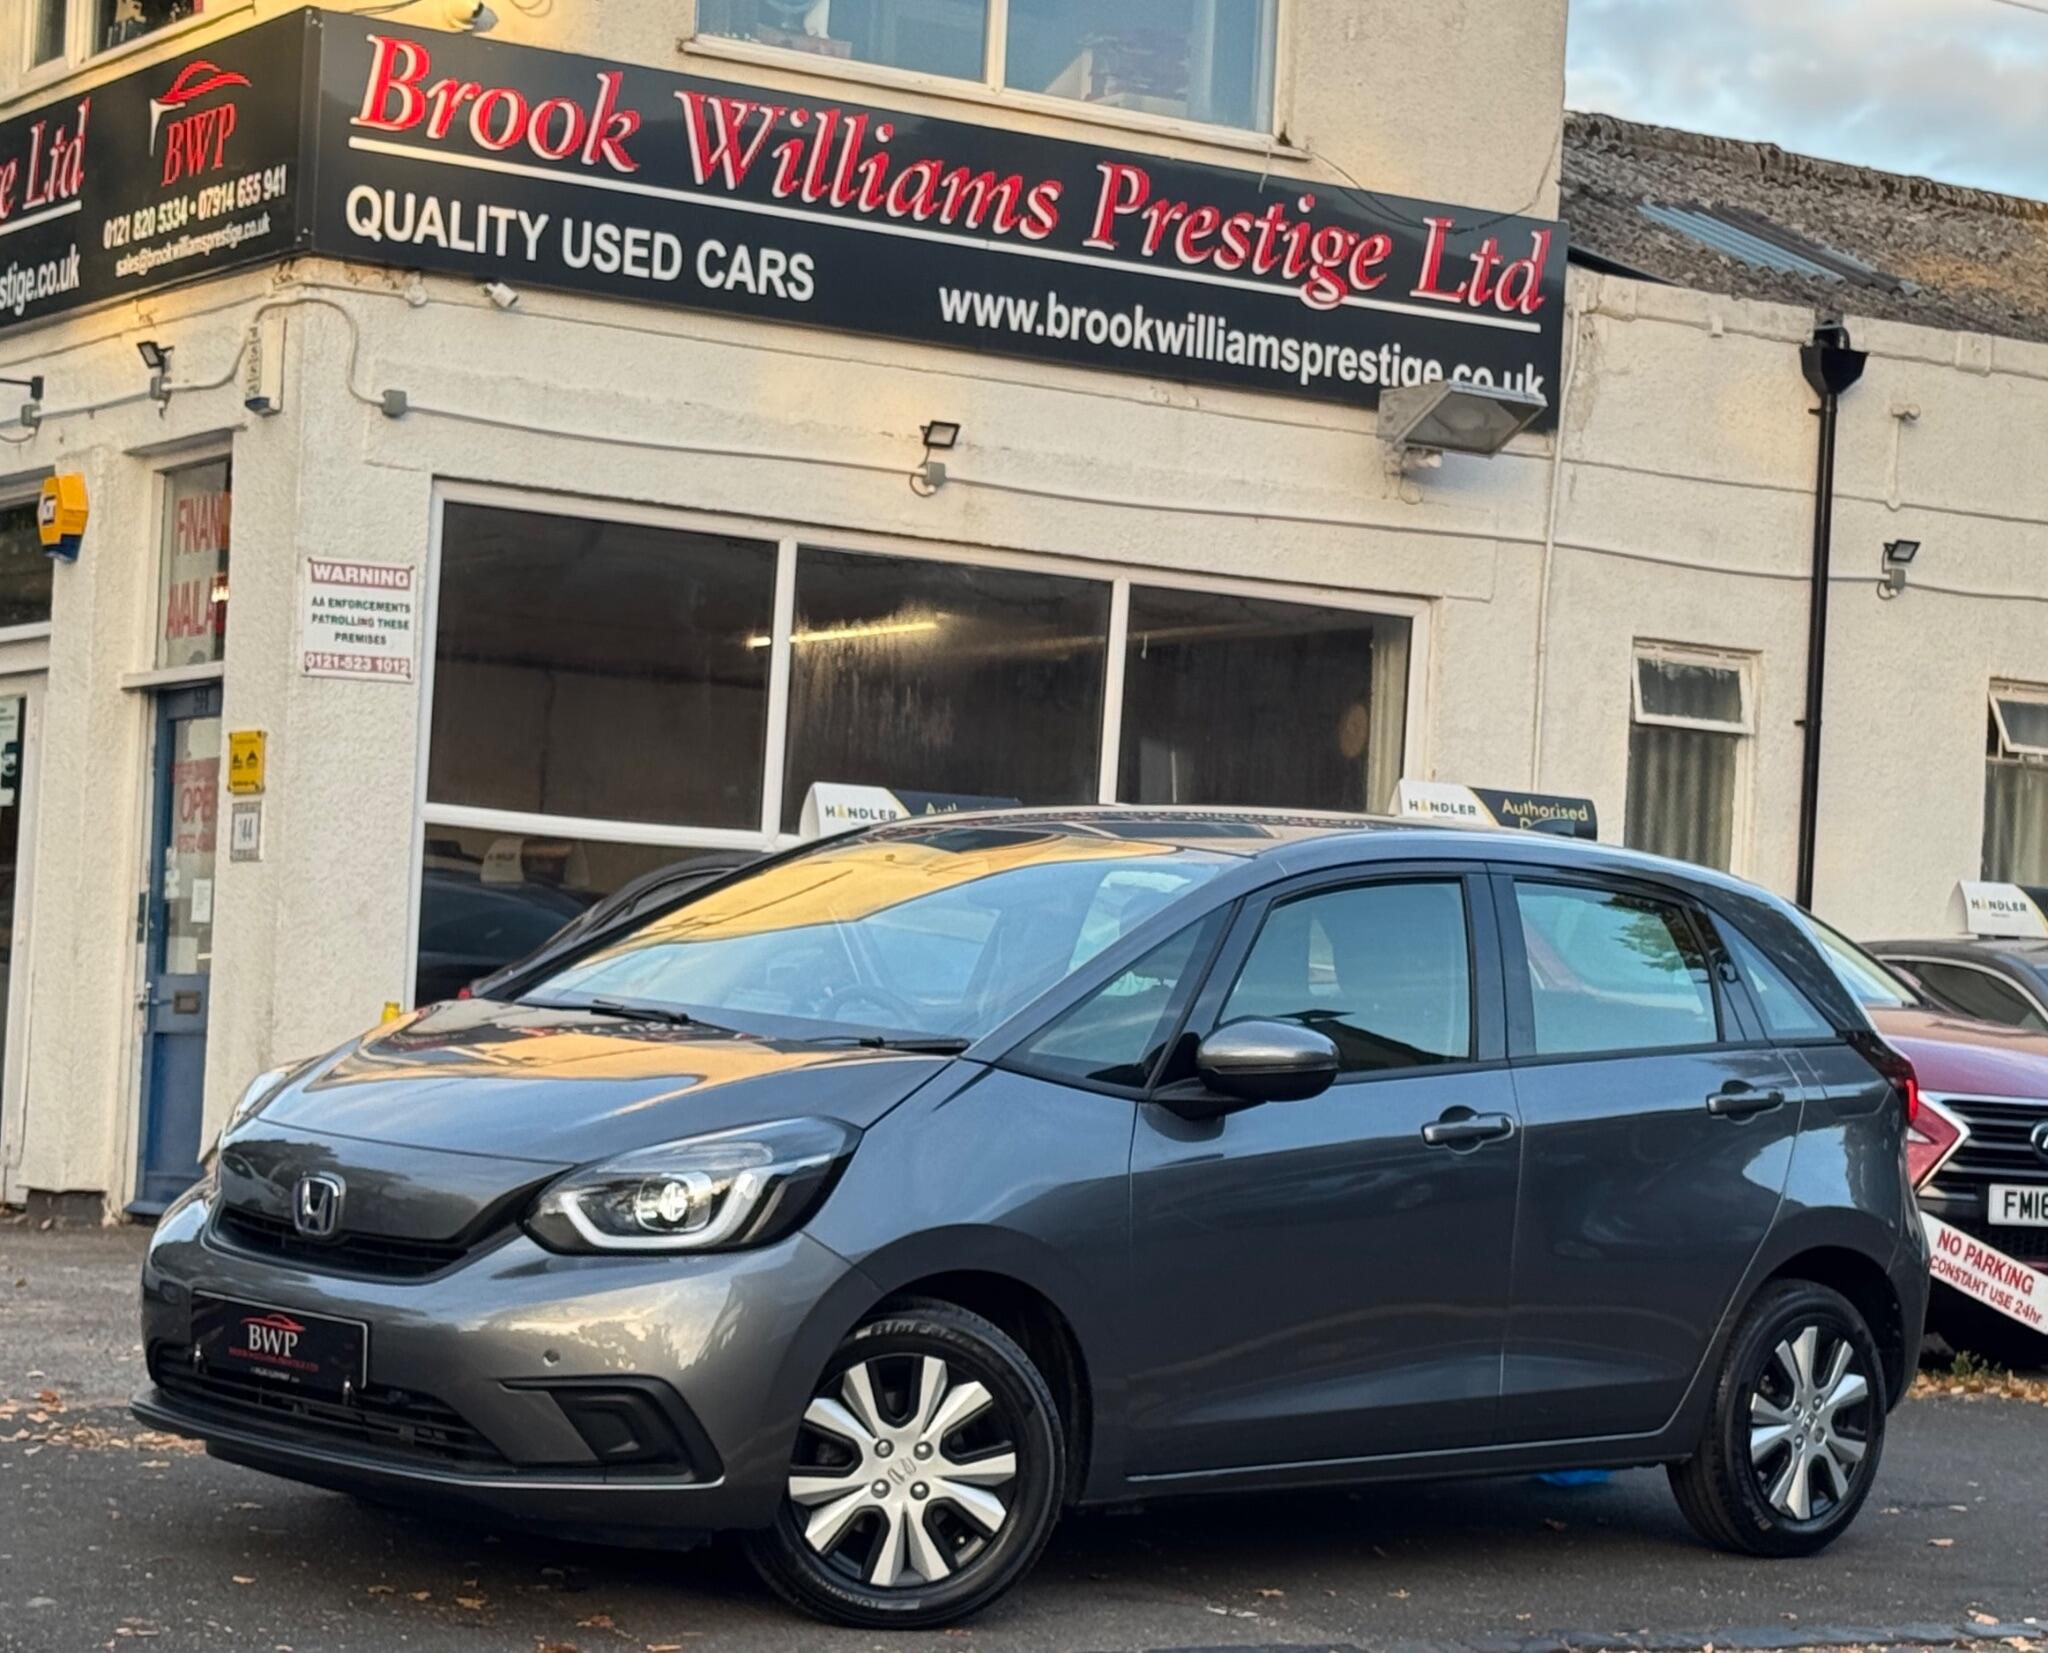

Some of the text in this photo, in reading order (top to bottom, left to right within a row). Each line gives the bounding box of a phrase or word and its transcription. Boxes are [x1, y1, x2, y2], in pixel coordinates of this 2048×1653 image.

[22, 96, 91, 210] Ltd
[161, 102, 237, 187] BWP
[350, 35, 1552, 315] Brook Williams Prestige Ltd
[103, 164, 287, 250] 0121 820 5334 07914 655 941
[346, 184, 815, 302] QUALITY USED CARS
[313, 563, 409, 588] WARNING
[312, 596, 411, 613] AA ENFORCEMENTS
[312, 613, 410, 630] PATROLLING THESE
[334, 632, 387, 645] PREMISES
[376, 659, 410, 674] 1012
[1502, 798, 1589, 822] Authorised
[1937, 1229, 2035, 1296] NO PARKING
[1930, 1254, 2043, 1325] CONSTANT USE 24hr
[247, 1324, 299, 1357] BWP
